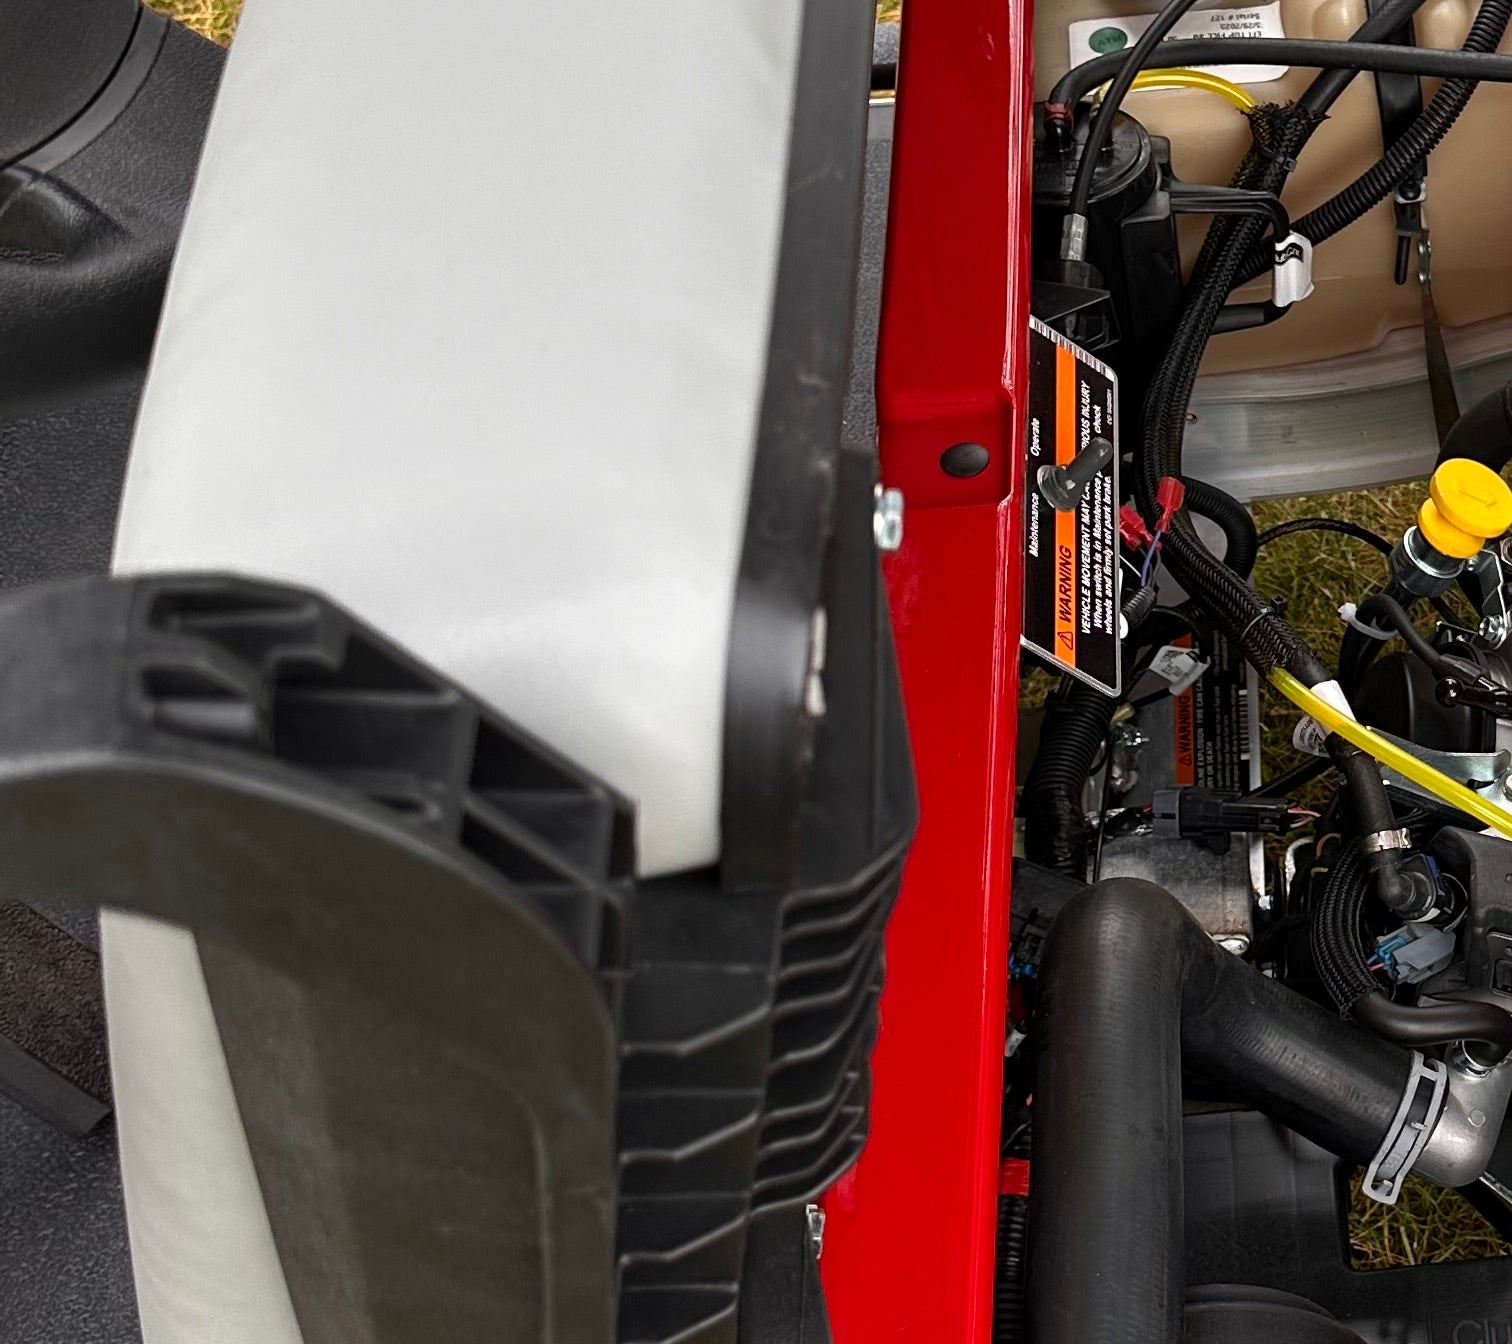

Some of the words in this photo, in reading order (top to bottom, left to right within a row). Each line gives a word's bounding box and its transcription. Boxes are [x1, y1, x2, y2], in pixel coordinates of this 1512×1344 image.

[1236, 13, 1260, 21] Serial
[1081, 380, 1091, 419] INJURY
[1030, 417, 1041, 457] Operate
[1028, 492, 1039, 557] Maintenance
[1080, 499, 1091, 526] MAY
[1092, 477, 1102, 540] Maintenance
[1102, 504, 1114, 530] park
[1092, 540, 1102, 552] in
[1103, 528, 1112, 546] set
[1081, 524, 1091, 587] MOVEMENT
[1093, 552, 1103, 563] is
[1102, 545, 1114, 577] firmly
[1058, 545, 1072, 623] WARNING
[1093, 563, 1103, 598] switch
[1103, 575, 1113, 598] and
[1081, 586, 1091, 634] VEHICLE
[1093, 598, 1103, 629] When
[1103, 598, 1113, 635] wheels
[1177, 695, 1191, 753] WARNING
